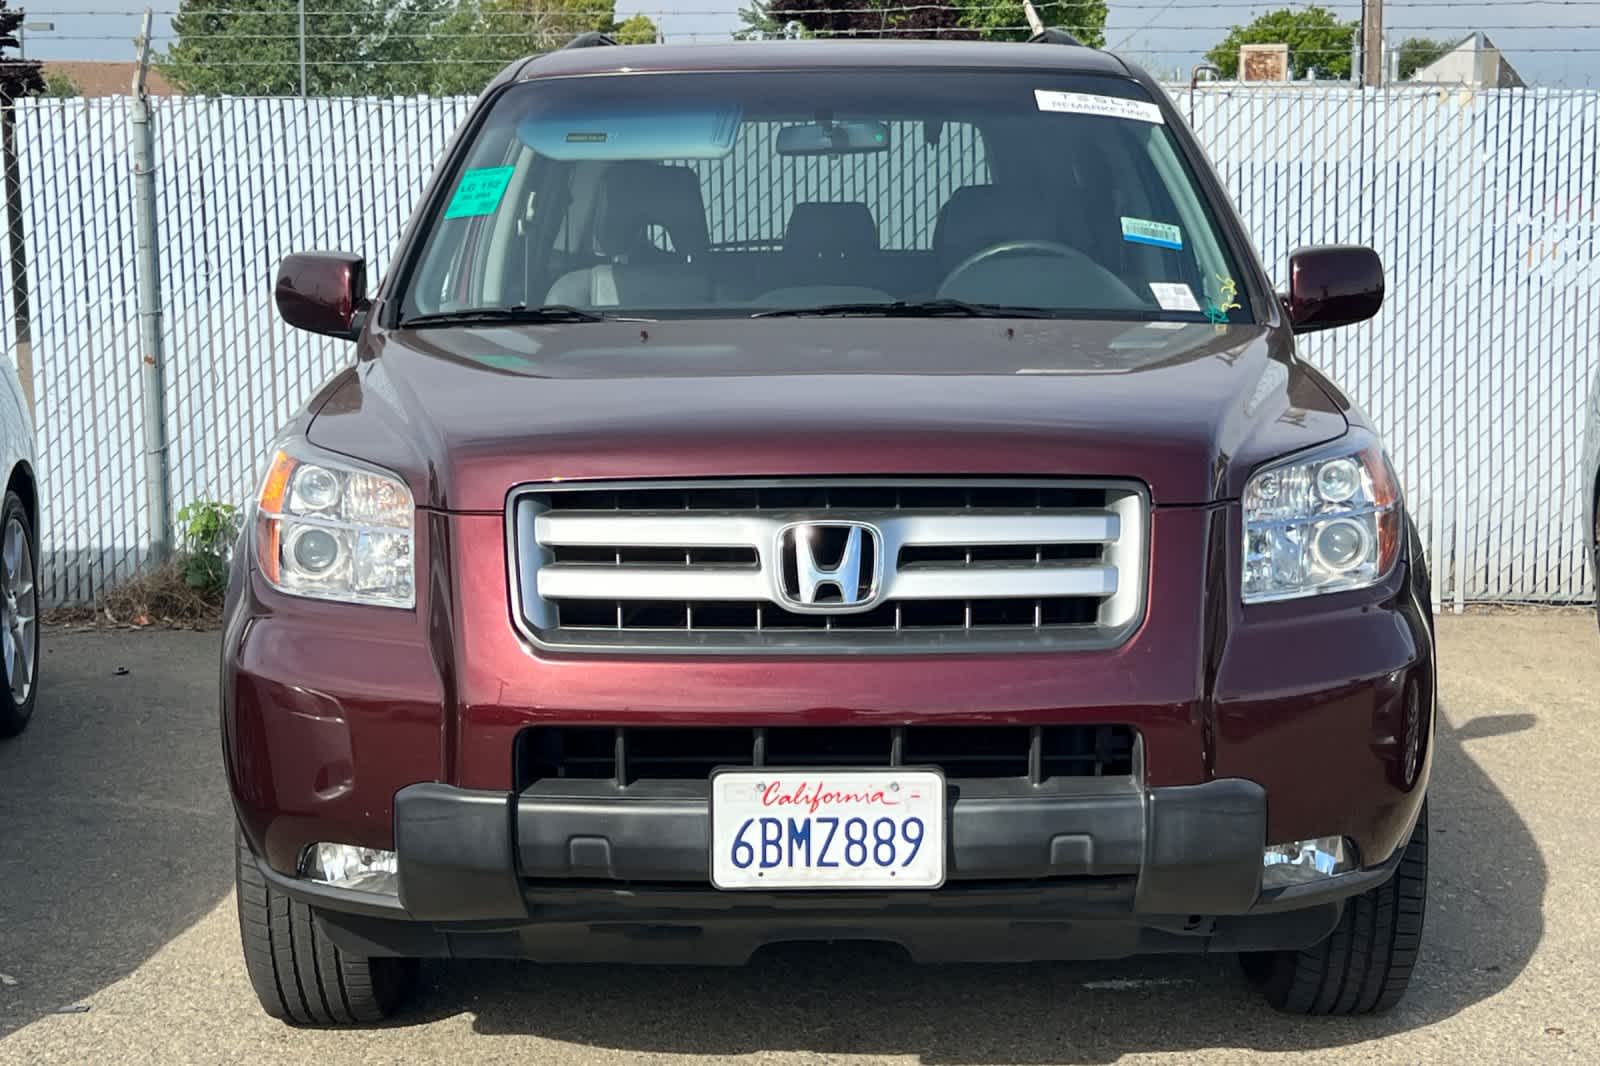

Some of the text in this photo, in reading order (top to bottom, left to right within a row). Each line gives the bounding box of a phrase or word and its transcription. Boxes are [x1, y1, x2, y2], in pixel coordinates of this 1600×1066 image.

[1049, 100, 1152, 119] REMARKETING
[1062, 93, 1140, 109] TESLA
[761, 781, 900, 814] California
[730, 816, 925, 869] 6BMZ889
